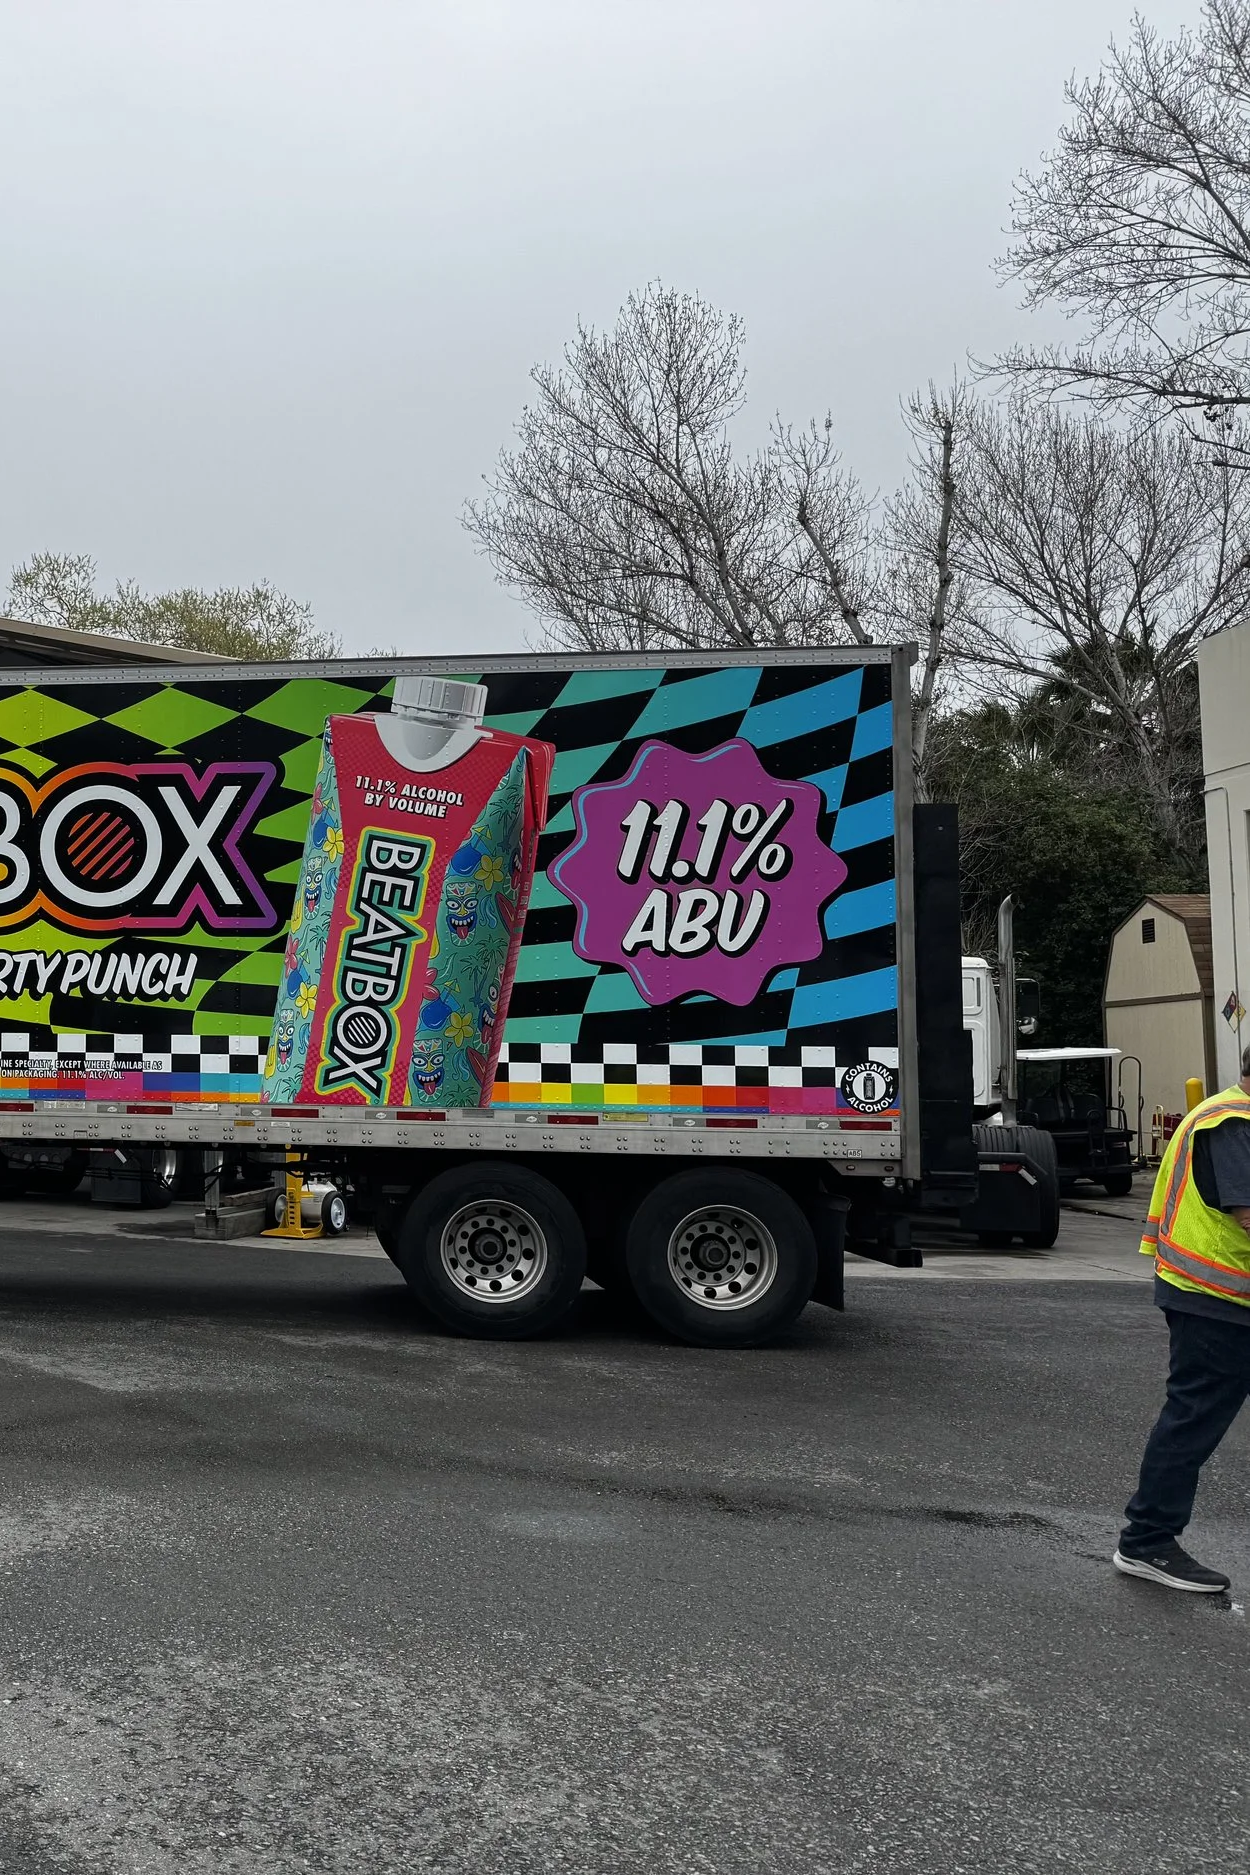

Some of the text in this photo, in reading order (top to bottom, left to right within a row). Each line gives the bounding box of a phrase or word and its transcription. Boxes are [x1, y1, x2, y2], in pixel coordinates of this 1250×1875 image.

[355, 775, 463, 806] 11.1% ALCOHOL
[364, 792, 447, 818] BY VOLUME
[617, 798, 788, 879] 11.1%
[59, 952, 198, 995] PUNCH
[328, 838, 424, 1091] BEATBOX
[1, 1070, 13, 1078] ON
[14, 1070, 60, 1079] PACKAGING.
[62, 1071, 87, 1079] 11.1%
[89, 1072, 125, 1081] ALC/VOL.
[14, 1060, 54, 1069] SPECIALTY,
[55, 1060, 81, 1069] EXCEPT
[83, 1060, 111, 1070] WHERE
[111, 1060, 151, 1070] AVAILABLE
[152, 1061, 163, 1070] AS
[845, 1062, 893, 1083] CONTAINS
[847, 1096, 894, 1113] ALCOHOL
